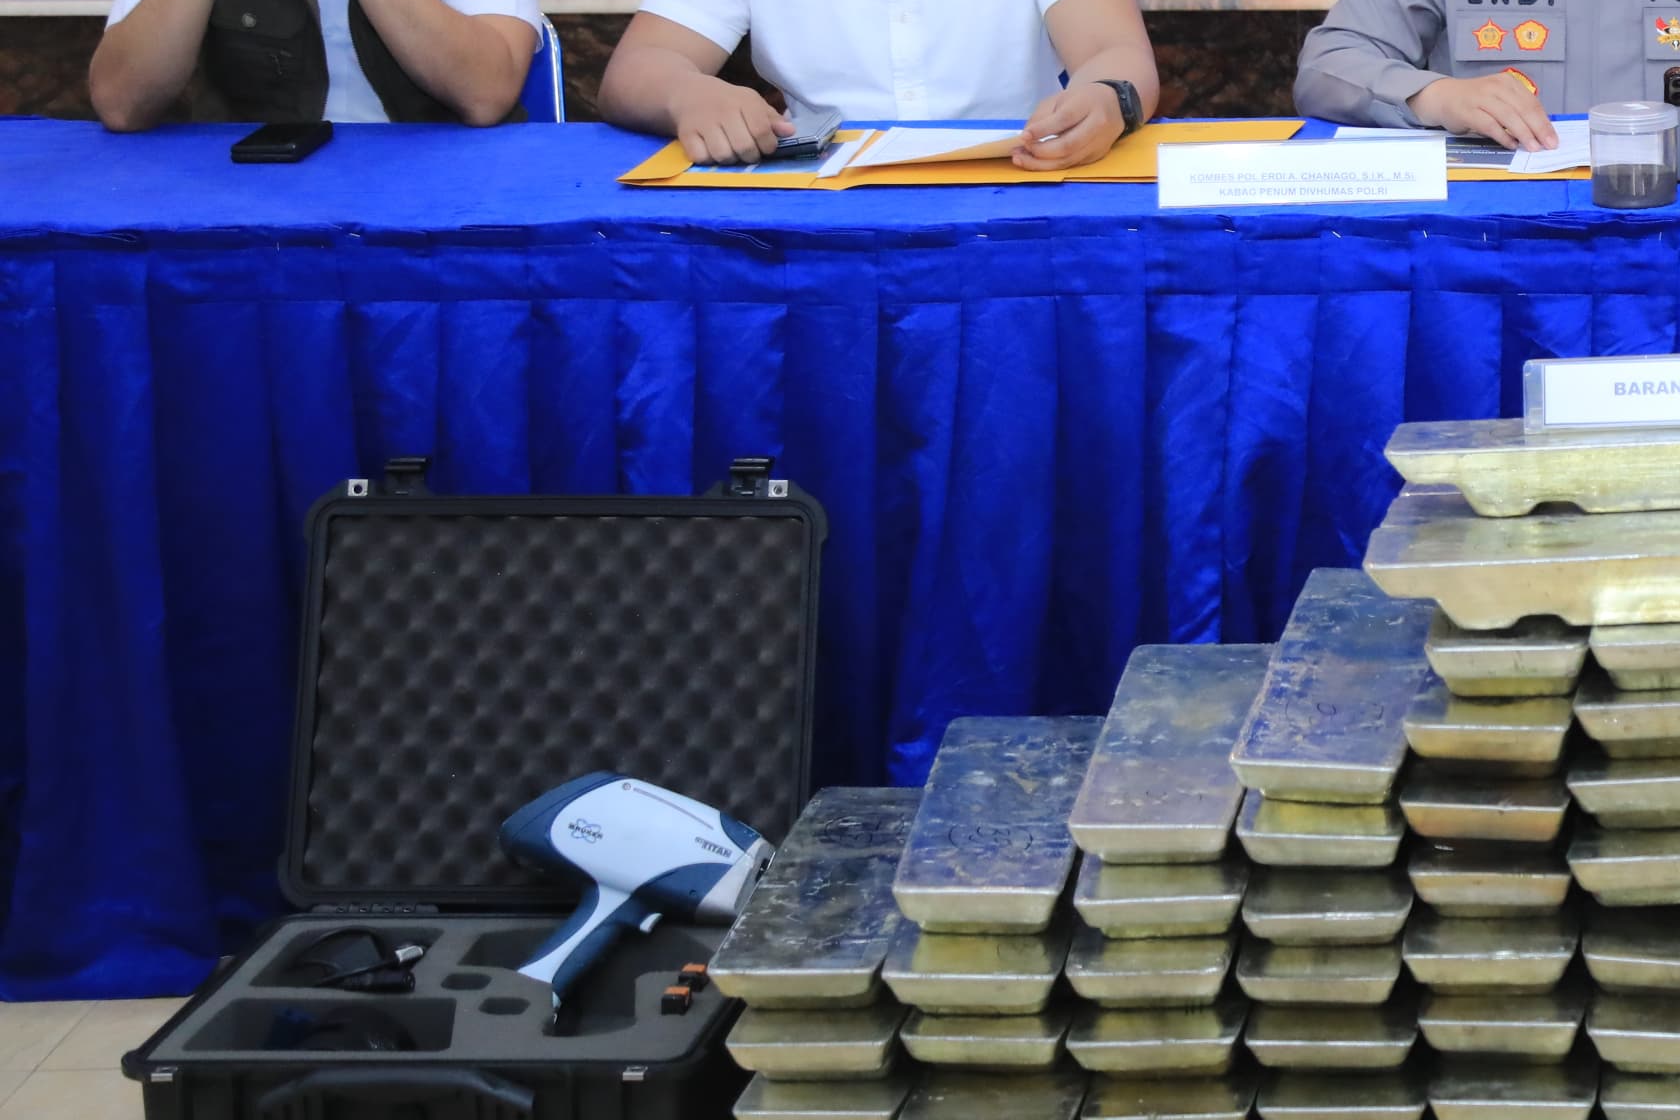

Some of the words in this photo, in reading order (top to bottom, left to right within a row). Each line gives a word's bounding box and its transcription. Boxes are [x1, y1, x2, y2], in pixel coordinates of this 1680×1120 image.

[1261, 172, 1286, 181] ERDI
[1259, 187, 1297, 196] PENUM
[1299, 186, 1354, 196] DIVHUMAS
[1356, 185, 1388, 195] POLRI
